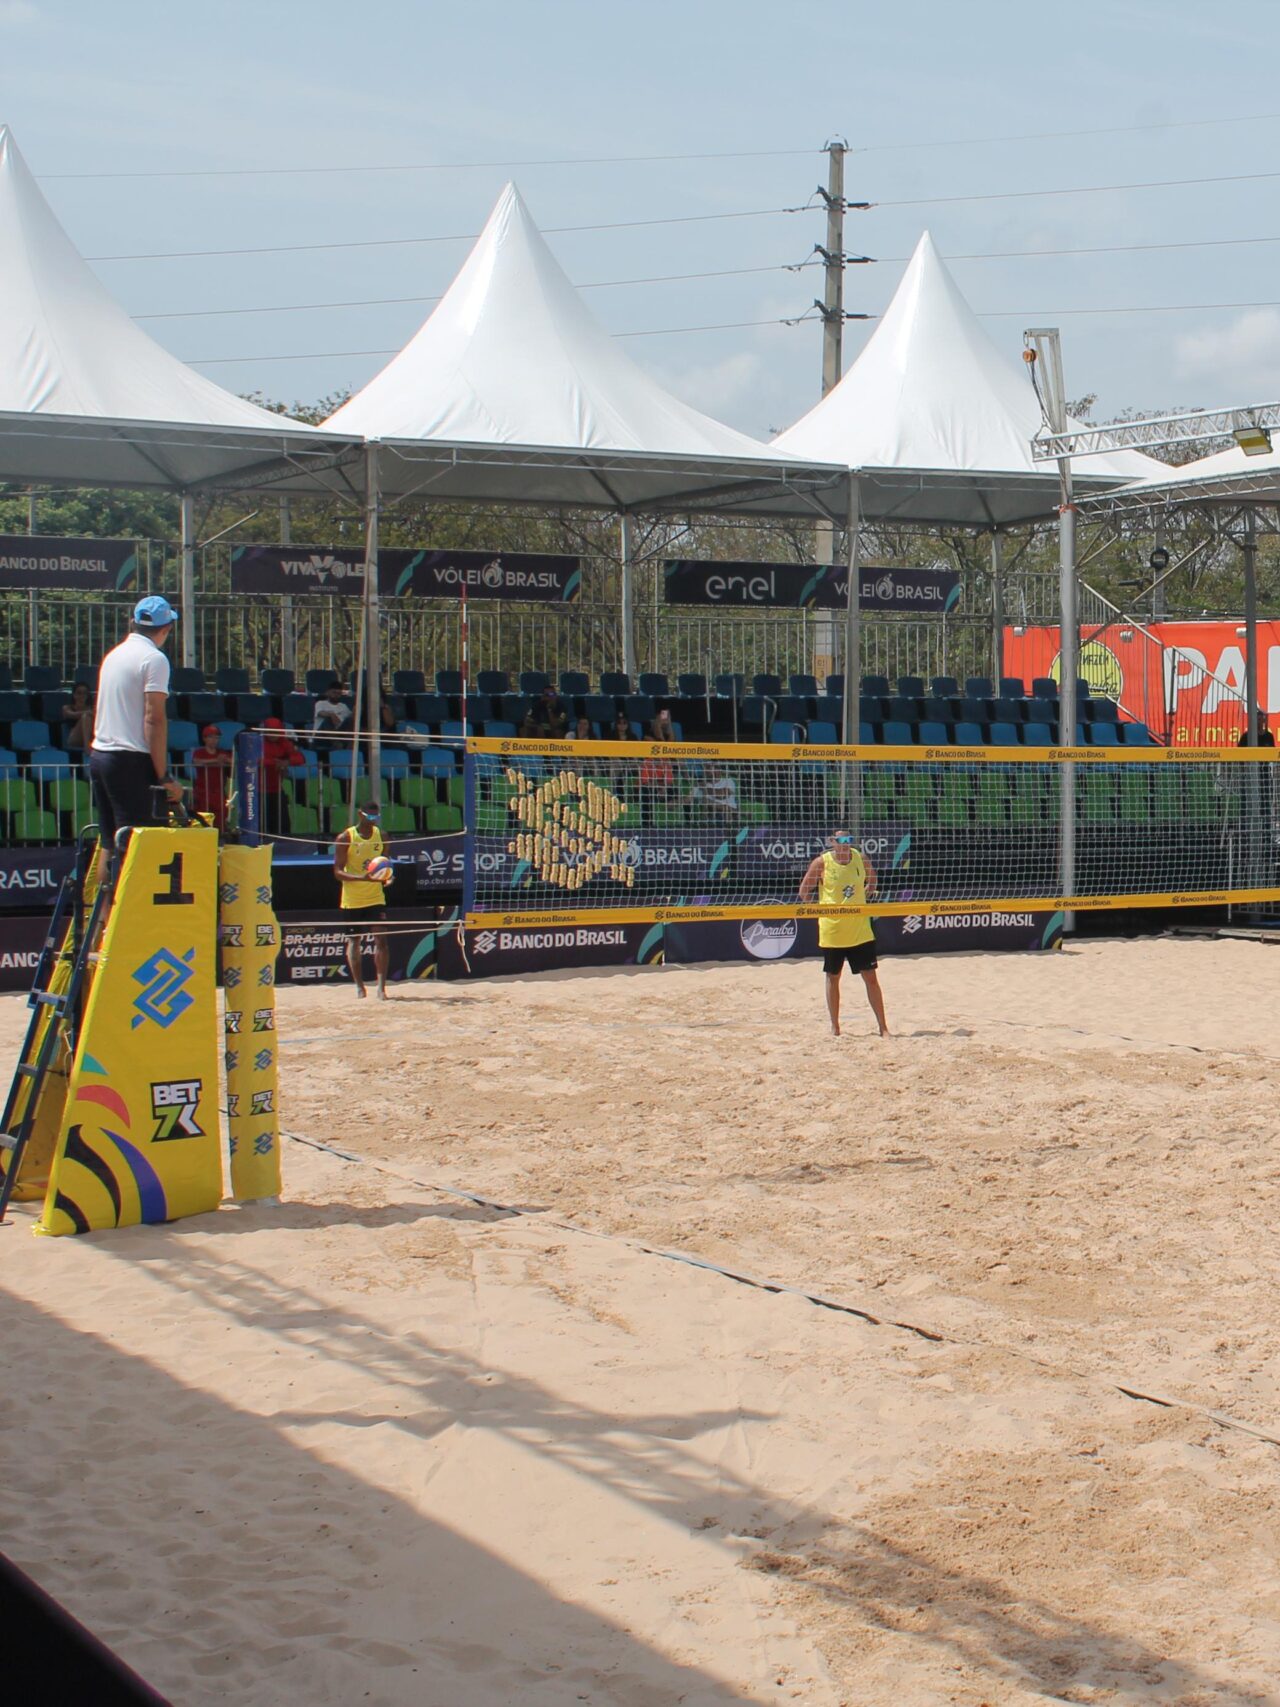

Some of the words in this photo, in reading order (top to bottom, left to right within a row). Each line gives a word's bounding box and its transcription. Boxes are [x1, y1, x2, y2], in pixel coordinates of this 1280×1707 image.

[40, 558, 58, 571] DO
[60, 556, 108, 572] BRASIL
[433, 566, 481, 584] VÔLEI
[506, 571, 560, 587] BRASIL
[705, 571, 775, 599] enel
[895, 585, 943, 600] BRASIL
[512, 743, 537, 751] BANCO
[550, 743, 573, 752] BRASIL
[662, 746, 686, 754] BANCO
[697, 746, 720, 755] BRASIL
[835, 749, 857, 757] BRASIL
[645, 848, 706, 865] BRASIL
[760, 840, 810, 859] VÔLEI
[153, 852, 194, 905] 1
[924, 914, 971, 930] BANCO
[972, 914, 992, 928] DO
[991, 912, 1034, 927] BRASIL
[257, 925, 272, 934] BE
[500, 932, 550, 950] BANCO
[551, 932, 575, 949] DO
[576, 929, 627, 946] BRASIL
[0, 951, 44, 968] ANC
[285, 945, 324, 958] VÔLEI
[326, 946, 344, 957] DE
[291, 965, 348, 978] BET7K
[153, 1082, 200, 1106] BET
[254, 1093, 272, 1102] BET
[252, 1101, 274, 1114] 7K
[155, 1103, 202, 1139] 7K
